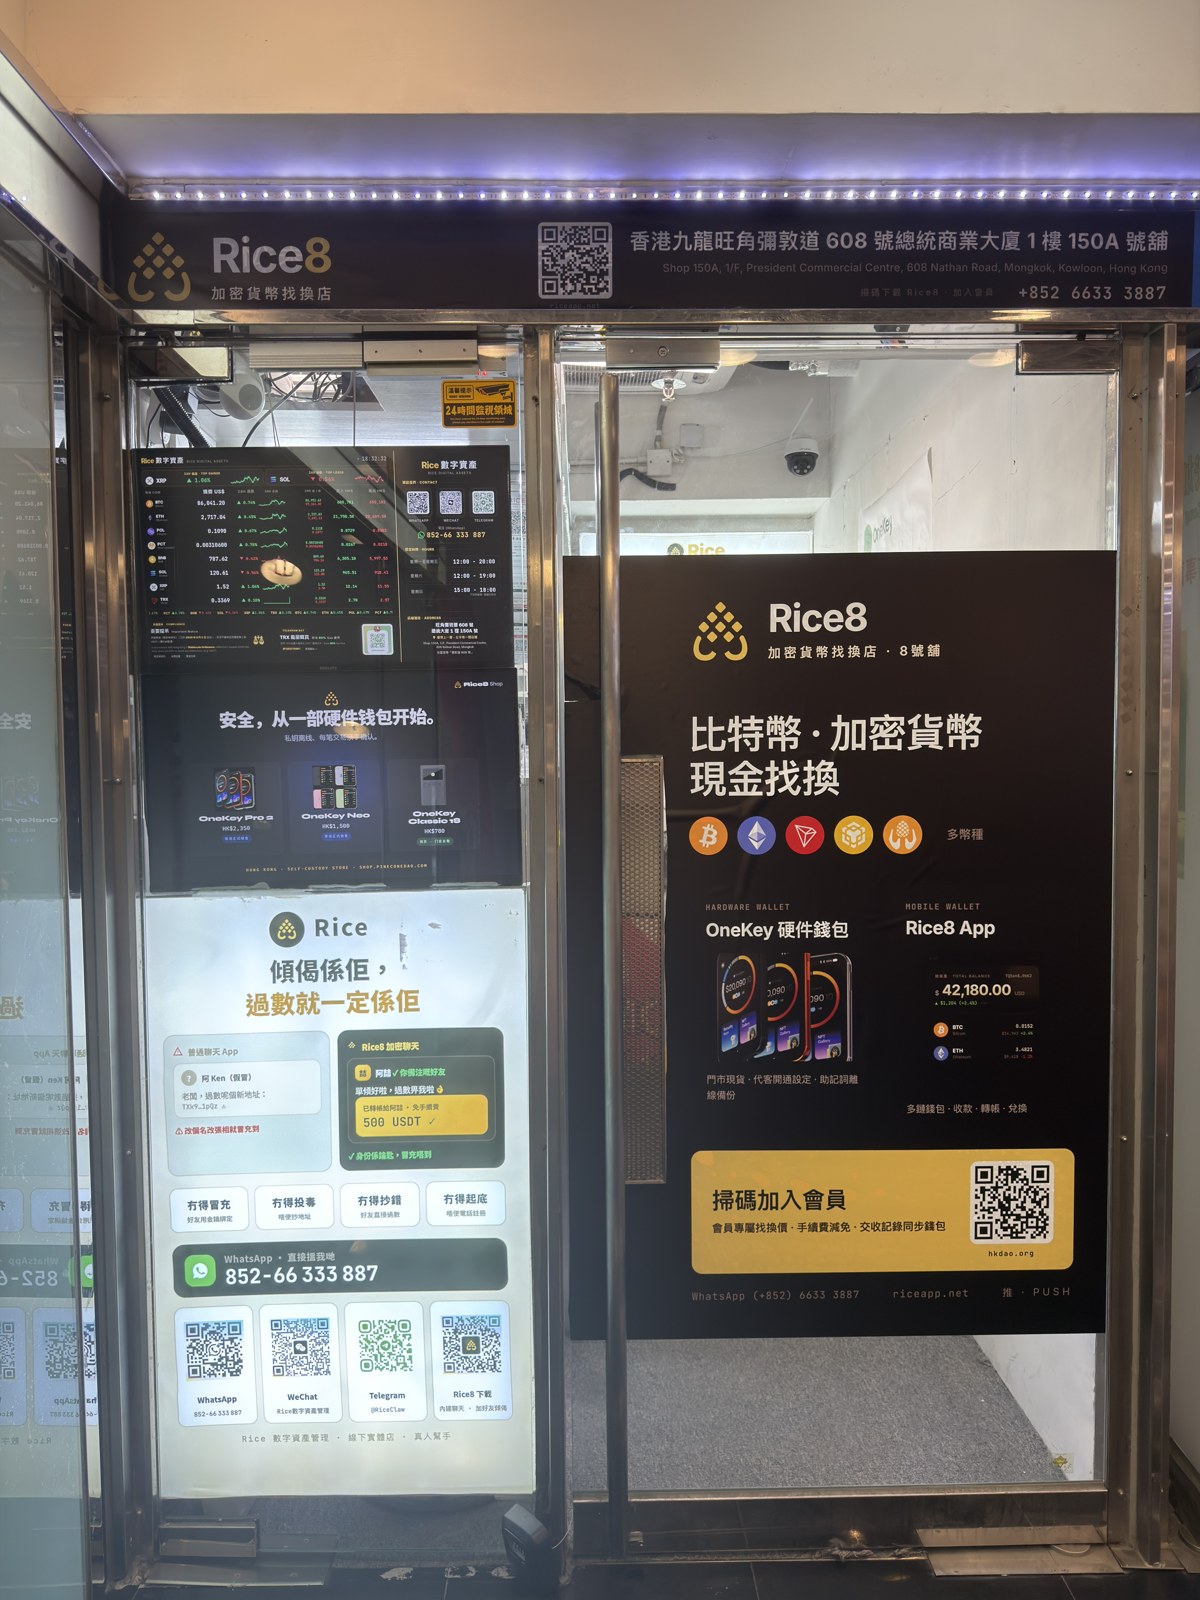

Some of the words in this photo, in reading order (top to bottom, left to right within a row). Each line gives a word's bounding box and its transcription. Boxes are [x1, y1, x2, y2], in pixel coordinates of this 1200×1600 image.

[630, 230, 820, 252] 香港九龍旺角彌敦道
[826, 232, 868, 250] 608
[873, 230, 1021, 252] 號總統商業大廈
[1028, 232, 1036, 249] 1
[1042, 230, 1062, 252] 樓
[1068, 232, 1119, 250] 150A
[1126, 230, 1168, 252] 號舖
[212, 235, 332, 274] Rice8
[663, 263, 690, 274] Shop
[693, 263, 721, 275] 150A,
[725, 263, 743, 275] 1/F,
[746, 263, 796, 273] President
[799, 262, 861, 273] Commercial
[866, 262, 903, 274] Centre,
[907, 262, 927, 272] 608
[931, 262, 967, 273] Nathan
[971, 262, 1000, 274] Road,
[1004, 262, 1054, 275] Mongkok,
[1058, 262, 1105, 275] Kowloon,
[1110, 263, 1136, 276] Hong
[1140, 263, 1168, 276] Kong
[211, 286, 332, 302] 加密貨幣找換店
[906, 287, 938, 298] Rice8
[1019, 285, 1059, 301] +852
[1071, 286, 1111, 300] 6633
[1124, 285, 1166, 300] 3887
[140, 457, 155, 465] Rice
[421, 461, 439, 470] Rice
[688, 543, 725, 556] Rice
[769, 602, 868, 633] Rice8
[768, 645, 877, 659] 加密貨幣找換店
[899, 644, 940, 658] 8號舖
[219, 708, 434, 730] 安全，从一部硬件钱包开始。
[691, 714, 802, 753] 比特幣
[831, 713, 982, 753] 加密貨幣
[690, 759, 840, 797] 現金找換
[199, 815, 243, 823] OneKey
[412, 810, 456, 818] OneKey
[408, 817, 448, 825] Classic
[947, 828, 984, 841] 多幣種
[705, 903, 750, 911] HARDWARE
[756, 903, 790, 911] WALLET
[905, 902, 940, 911] MOBILE
[945, 902, 980, 911] WALLET
[315, 917, 368, 938] Rice
[705, 922, 773, 939] OneKey
[778, 920, 849, 939] 硬件錢包
[906, 920, 955, 936] Rice8
[959, 920, 996, 938] App
[934, 989, 940, 997] $
[941, 983, 1012, 999] 42,180.00
[245, 989, 420, 1018] 過數就一定係佢
[222, 1047, 238, 1058] App
[362, 1043, 385, 1052] Rice8
[386, 1042, 419, 1052] 加密聊天
[202, 1075, 209, 1083] 阿
[211, 1075, 226, 1083] Ken
[707, 1074, 746, 1085] 門市現貨
[753, 1074, 812, 1085] 代客開通設定
[820, 1074, 859, 1085] 助記詞離
[706, 1090, 736, 1101] 線備份
[907, 1103, 945, 1114] 多鏈錢包
[953, 1103, 973, 1114] 收款
[981, 1103, 1000, 1114] 轉帳
[1008, 1103, 1028, 1114] 兌換
[363, 1117, 385, 1127] 500
[392, 1116, 422, 1127] USDT
[187, 1199, 231, 1211] 冇得冒充
[272, 1197, 316, 1209] 冇得投毒
[357, 1194, 402, 1207] 冇得抄錯
[443, 1193, 487, 1205] 冇得起底
[712, 1188, 847, 1212] 掃碼加入會員
[712, 1221, 788, 1234] 會員專屬找換價
[796, 1221, 851, 1233] 手續費減免
[859, 1220, 946, 1233] 交收記錄同步錢包
[224, 1253, 273, 1265] WhatsApp
[988, 1249, 1034, 1258] hkdao.org
[225, 1267, 297, 1285] 852-66
[302, 1266, 337, 1283] 333
[342, 1264, 379, 1281] 887
[691, 1290, 745, 1302] WhatsApp
[752, 1290, 791, 1302] (+852)
[799, 1289, 825, 1300] 6633
[833, 1289, 859, 1300] 3887
[892, 1289, 969, 1300] riceapp.net
[1002, 1287, 1013, 1298] 推
[1033, 1287, 1071, 1297] PUSH
[197, 1395, 237, 1405] WhatsApp
[287, 1393, 318, 1401] WeChat
[369, 1392, 406, 1401] Telegram
[453, 1390, 474, 1398] Rice8
[476, 1390, 492, 1398] 下載
[193, 1410, 217, 1418] 852-66
[371, 1406, 406, 1414] @RiceClaw
[242, 1434, 266, 1443] Rice
[273, 1433, 330, 1443] 數字資產管理
[348, 1432, 395, 1442] 線下實體店
[414, 1431, 453, 1442] 真人幫手
